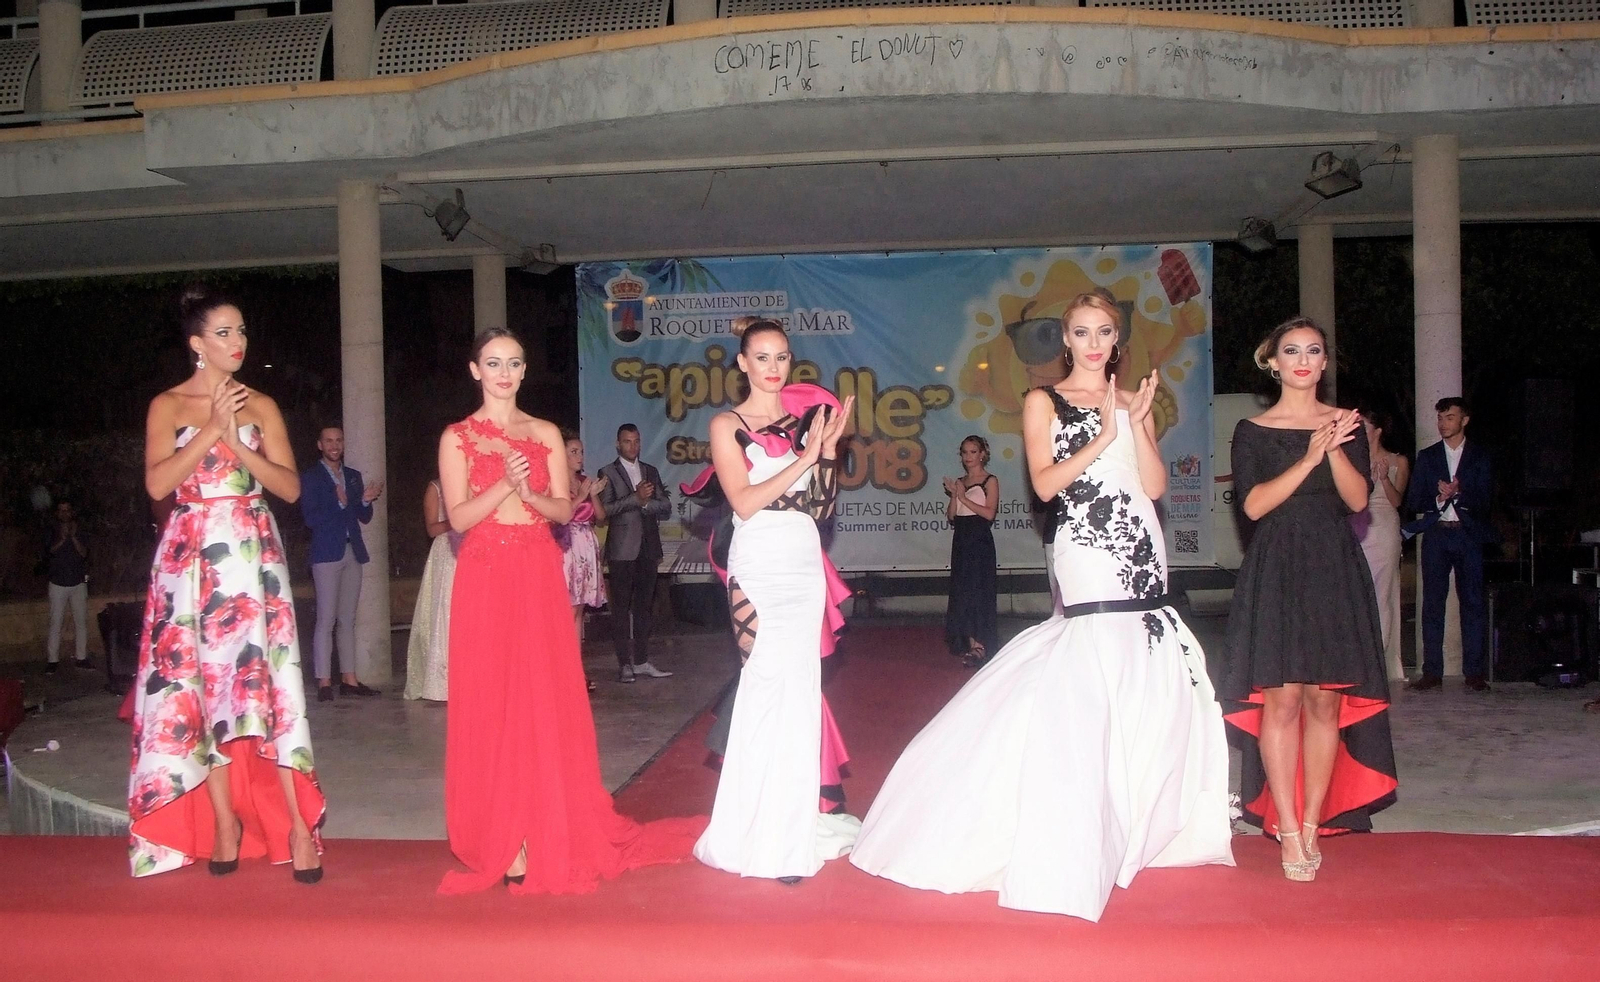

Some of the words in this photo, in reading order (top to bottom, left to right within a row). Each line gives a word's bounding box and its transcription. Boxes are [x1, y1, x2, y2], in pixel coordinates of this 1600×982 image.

[851, 38, 872, 64] EL
[878, 32, 942, 65] DONUT
[649, 295, 760, 311] AYUNTAMIENTO
[765, 295, 784, 307] DE
[650, 316, 733, 339] ROQUET
[800, 311, 850, 331] MAR
[838, 438, 925, 491] 018
[1171, 495, 1201, 503] ROQUETAS
[834, 502, 881, 517] UETAS
[886, 501, 906, 516] DE
[837, 521, 891, 532] Summer
[894, 521, 908, 531] at
[1004, 518, 1034, 530] MAR
